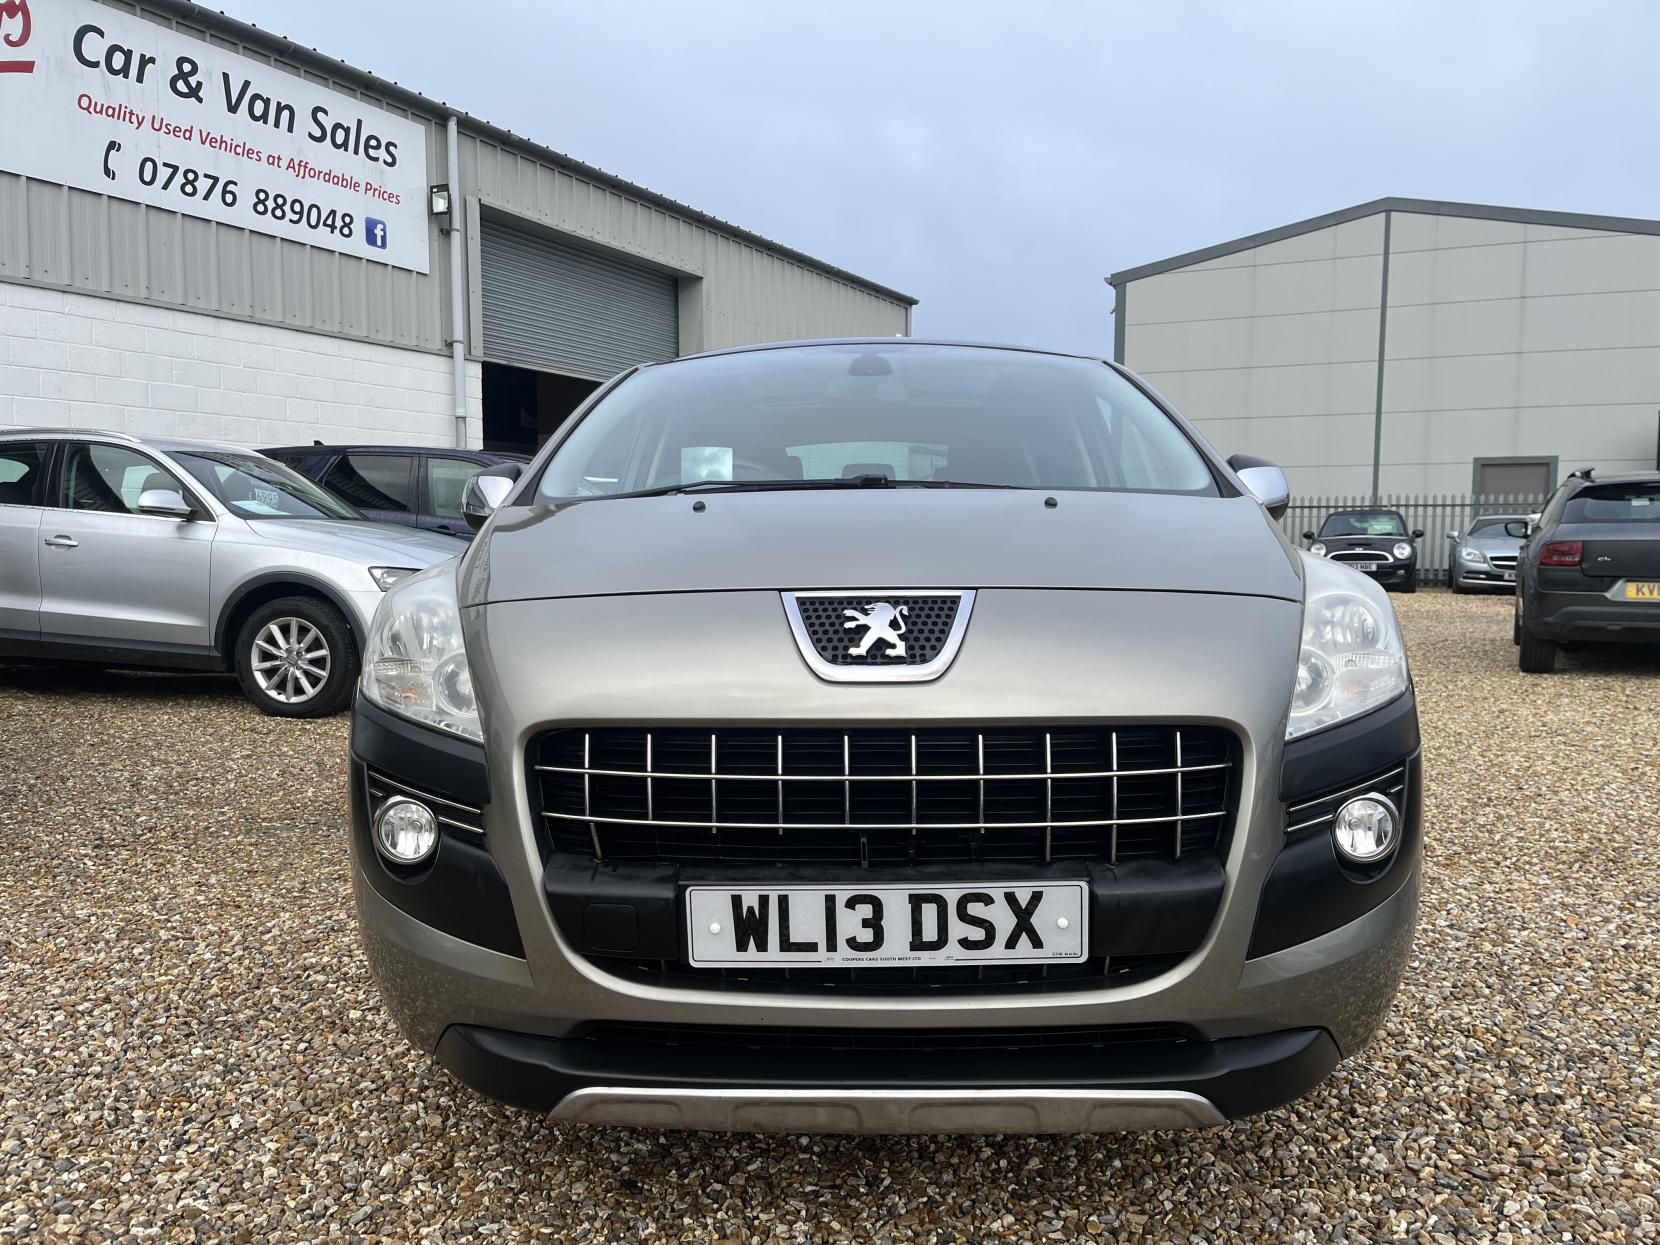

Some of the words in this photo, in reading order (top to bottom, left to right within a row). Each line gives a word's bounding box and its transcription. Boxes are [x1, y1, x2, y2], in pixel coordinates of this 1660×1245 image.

[73, 25, 156, 85] Car
[169, 56, 204, 104] &
[222, 71, 295, 134] Van
[307, 106, 398, 169] Sales
[77, 93, 146, 130] Quality
[150, 114, 194, 142] Used
[199, 128, 262, 162] Vehicles
[266, 153, 283, 169] at
[286, 157, 361, 193] Affordable
[364, 181, 400, 205] Prices
[138, 156, 239, 208] 07876
[252, 188, 354, 239] 889048
[731, 893, 885, 953] WL13
[908, 891, 1044, 952] DSX
